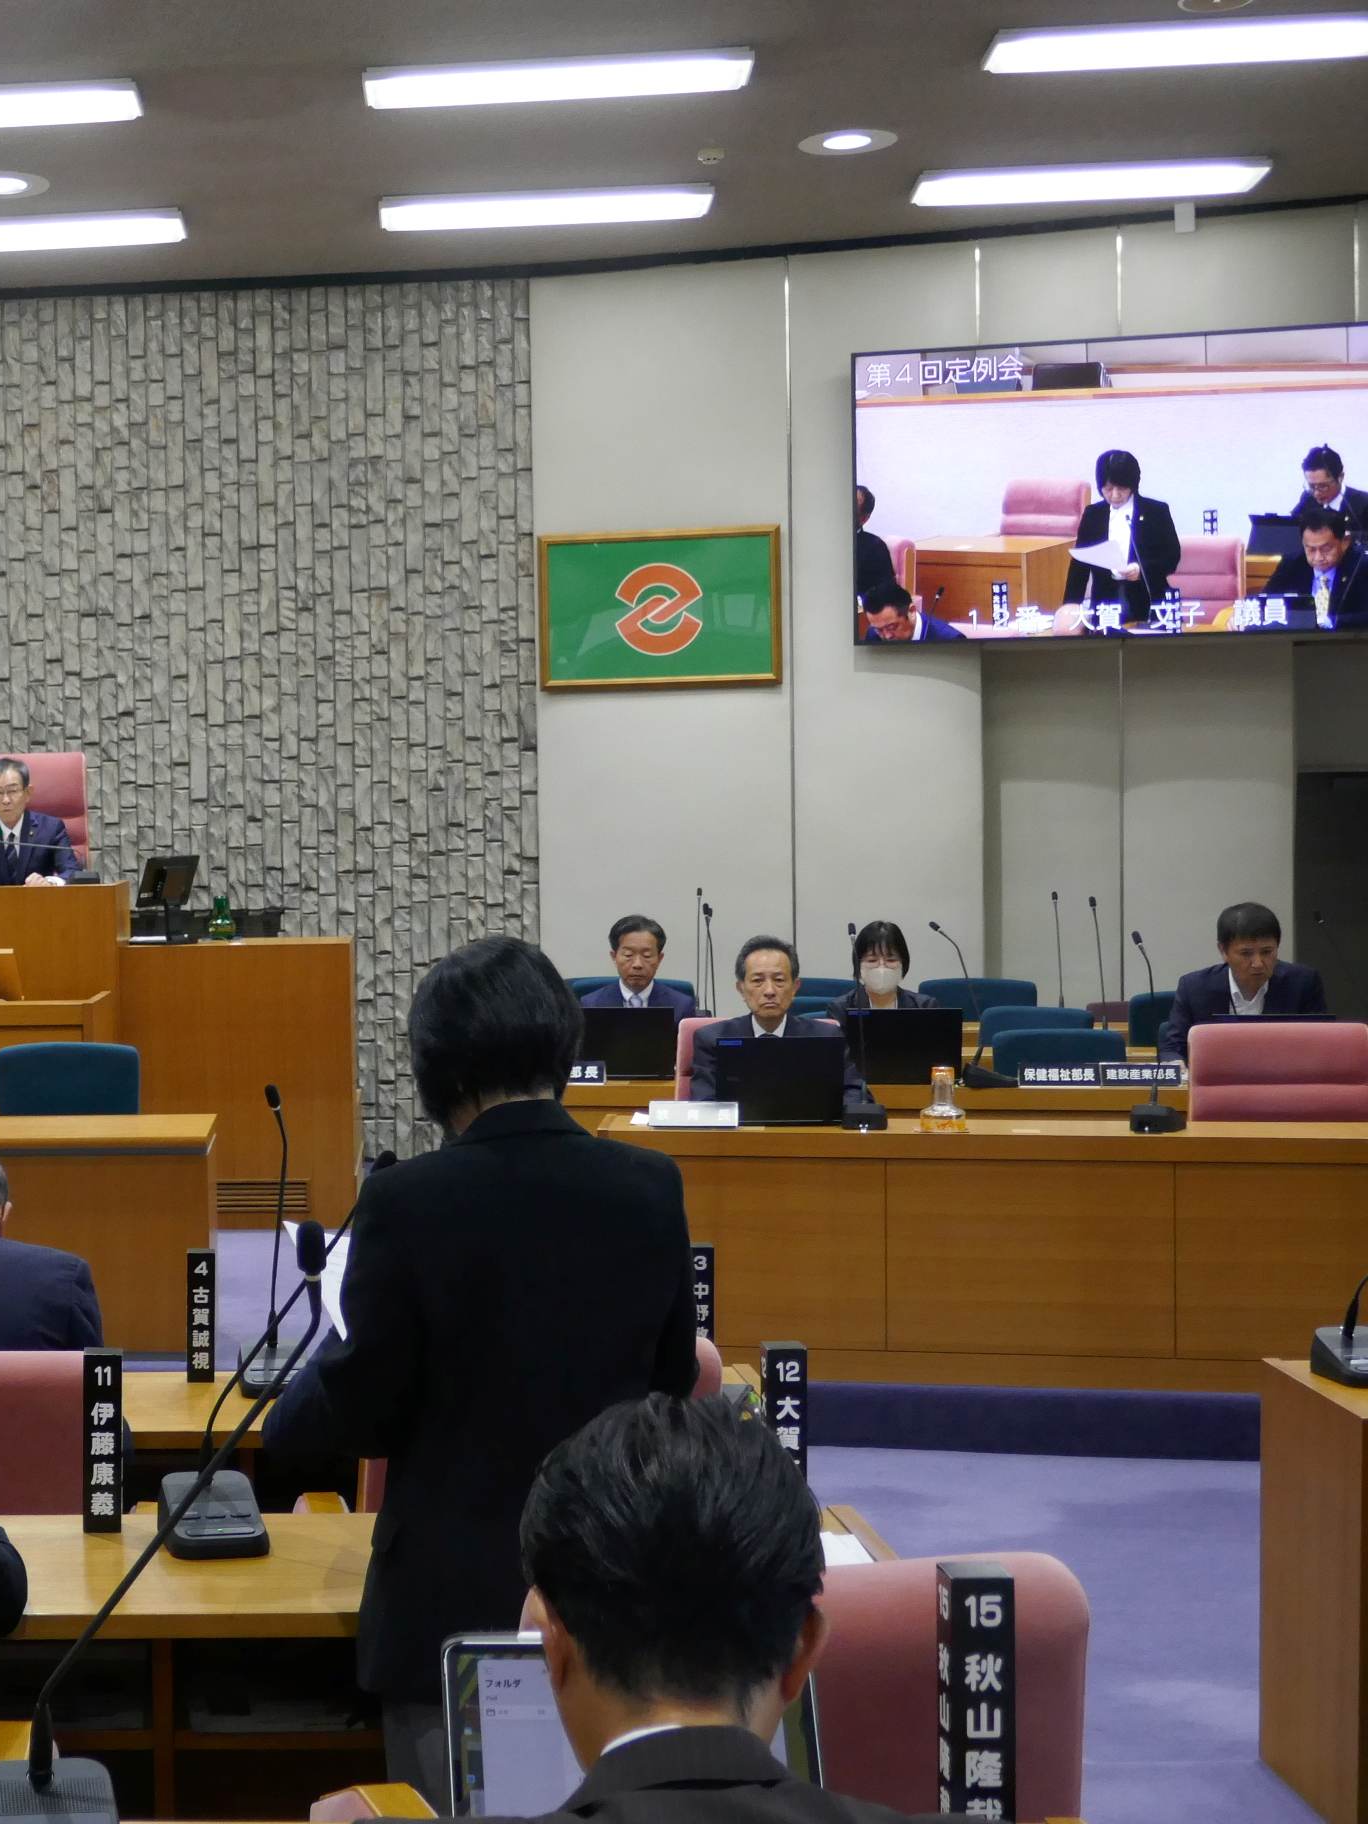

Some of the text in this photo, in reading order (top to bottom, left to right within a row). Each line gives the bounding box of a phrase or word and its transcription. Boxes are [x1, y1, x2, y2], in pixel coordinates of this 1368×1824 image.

[866, 354, 1024, 388] 第4回定例会
[1070, 602, 1122, 632] 大賀
[1233, 598, 1288, 628] 議員
[1023, 1068, 1095, 1082] 保健福祉部長
[693, 1255, 708, 1271] 3
[192, 1260, 210, 1370] 4 古賀誠視
[775, 1361, 801, 1465] 12 大賀
[90, 1365, 115, 1516] 11 伊藤康義
[965, 1594, 1003, 1628] 15
